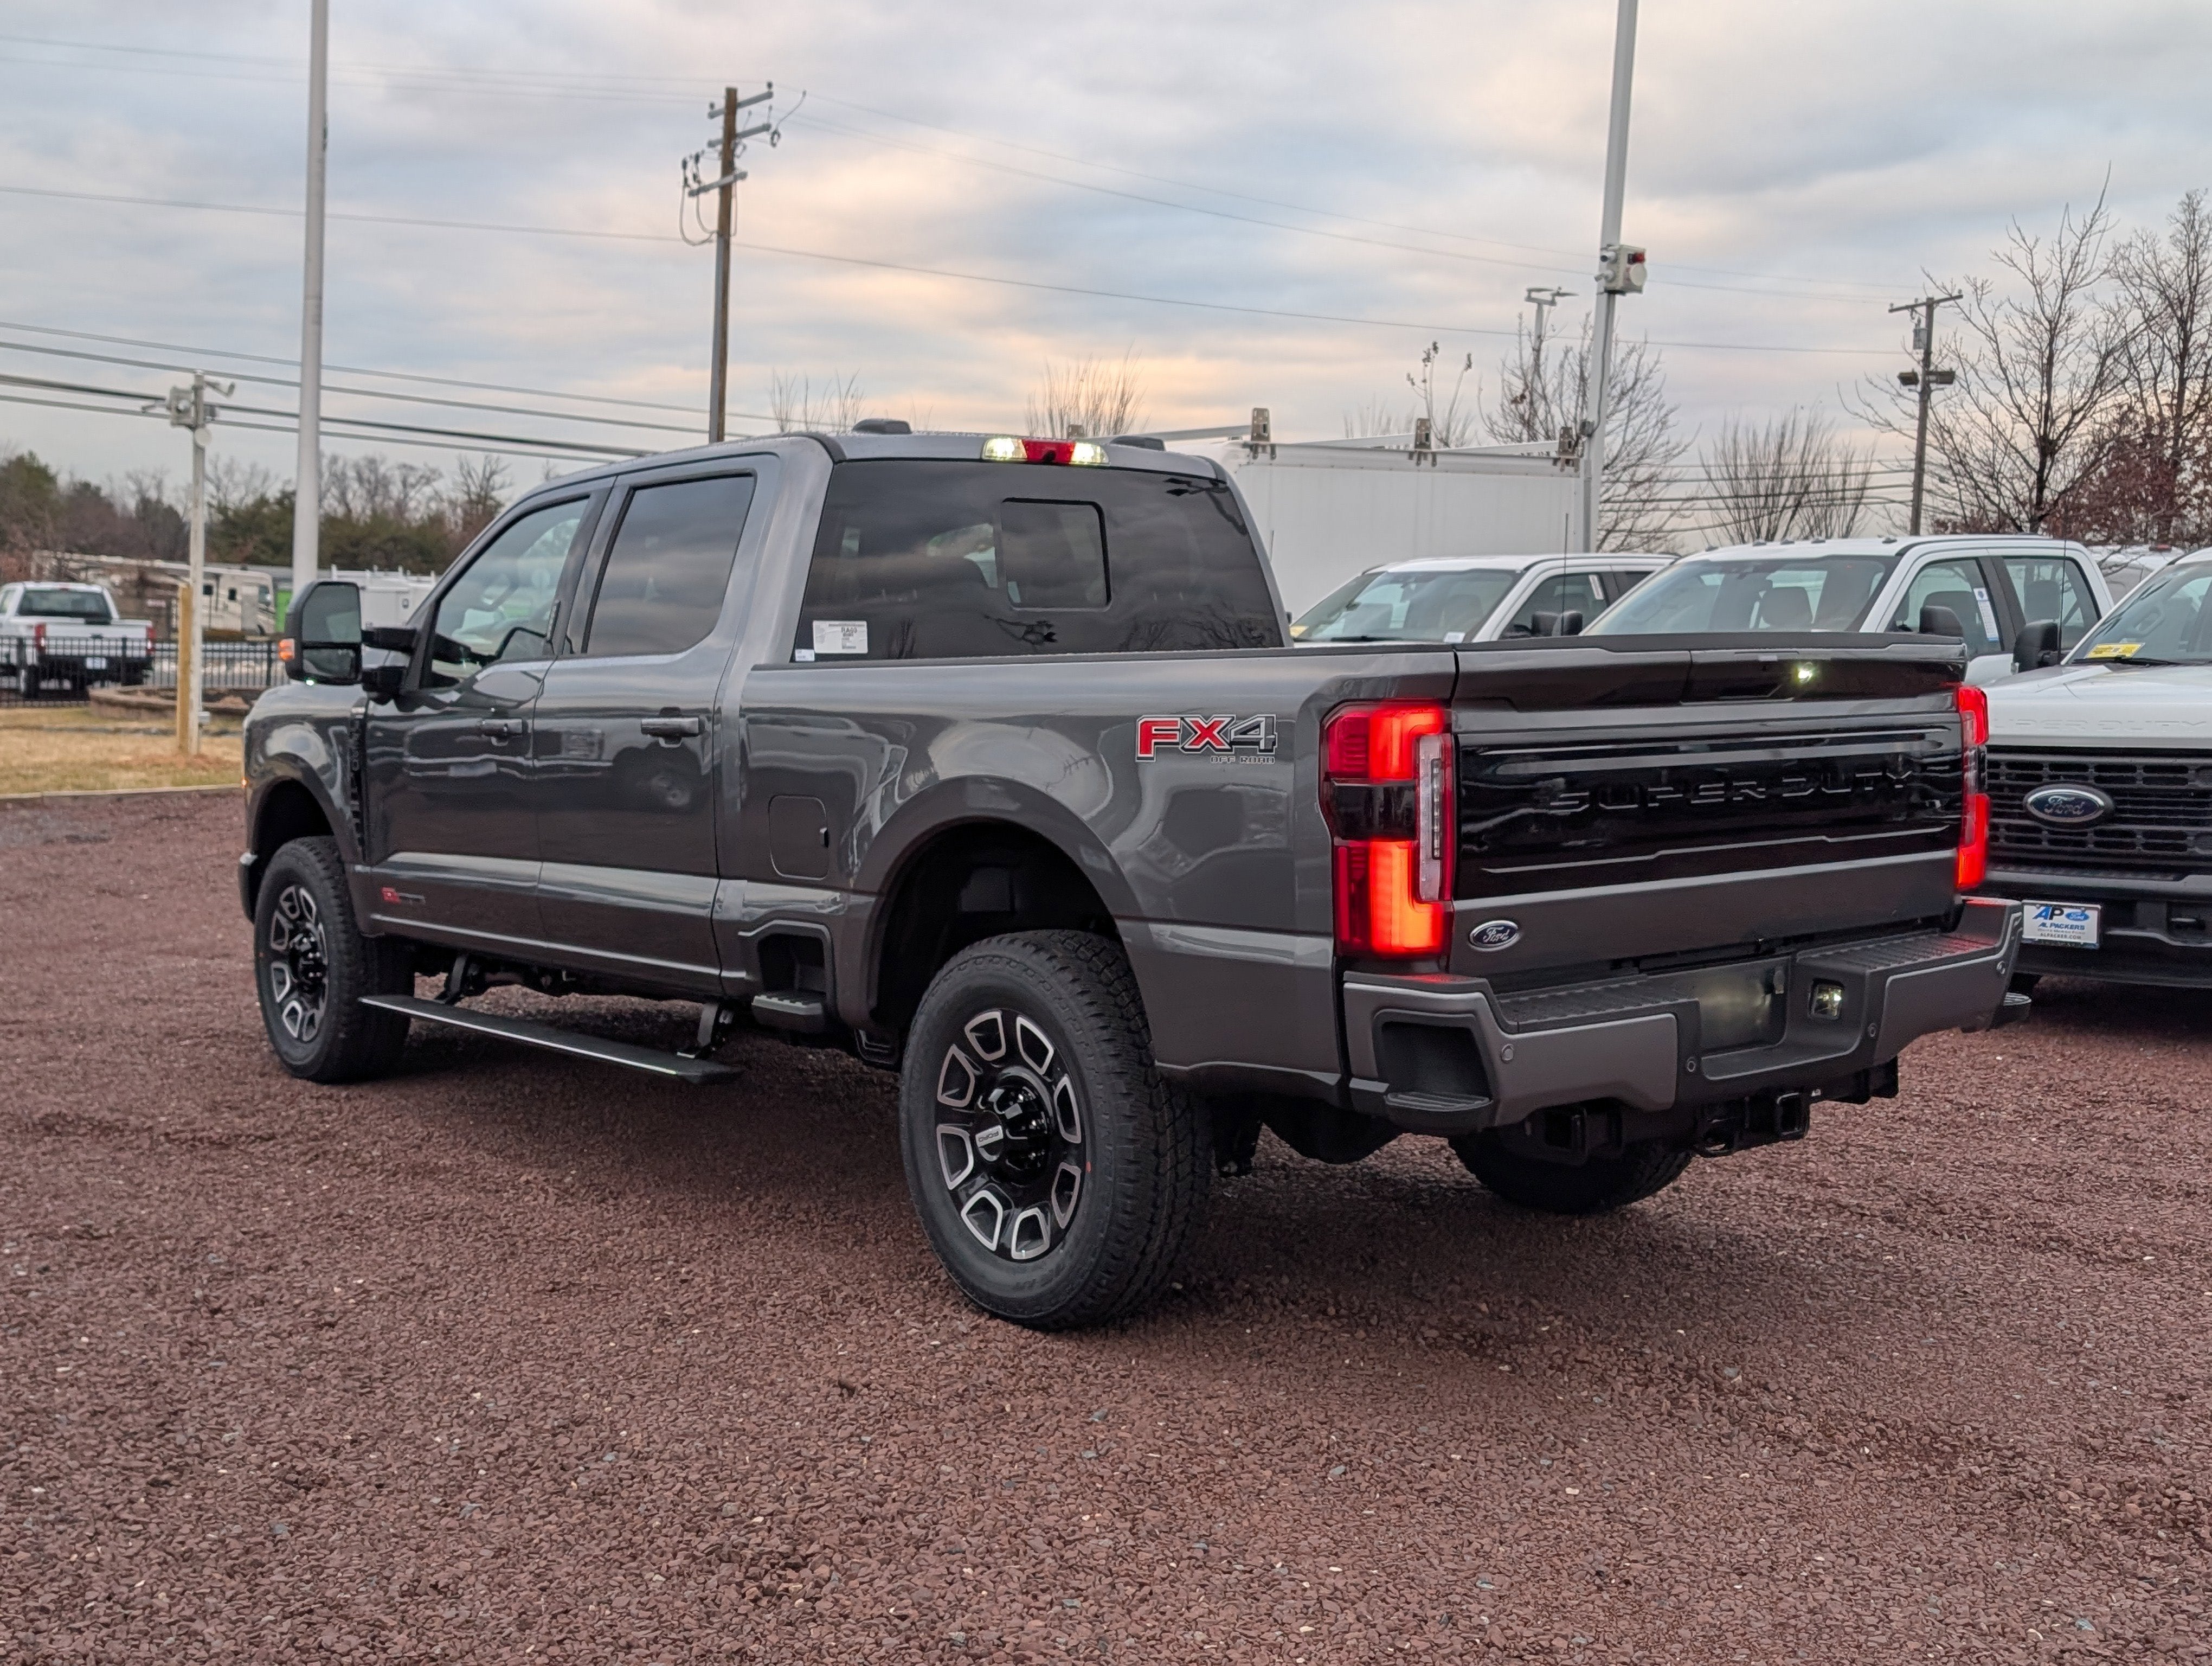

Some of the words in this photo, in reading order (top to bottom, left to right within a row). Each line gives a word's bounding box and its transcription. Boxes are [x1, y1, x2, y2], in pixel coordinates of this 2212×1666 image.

[1992, 718, 2088, 732] UPER
[2098, 720, 2207, 733] DUTY
[1135, 714, 1277, 762] FX4
[1210, 755, 1236, 764] OFF
[1239, 756, 1275, 765] ROAD
[1549, 780, 1766, 814] SUPER
[1782, 770, 1913, 797] DUTY
[2044, 795, 2085, 815] Ford
[2033, 906, 2065, 920] AP
[1482, 926, 1510, 943] Ford
